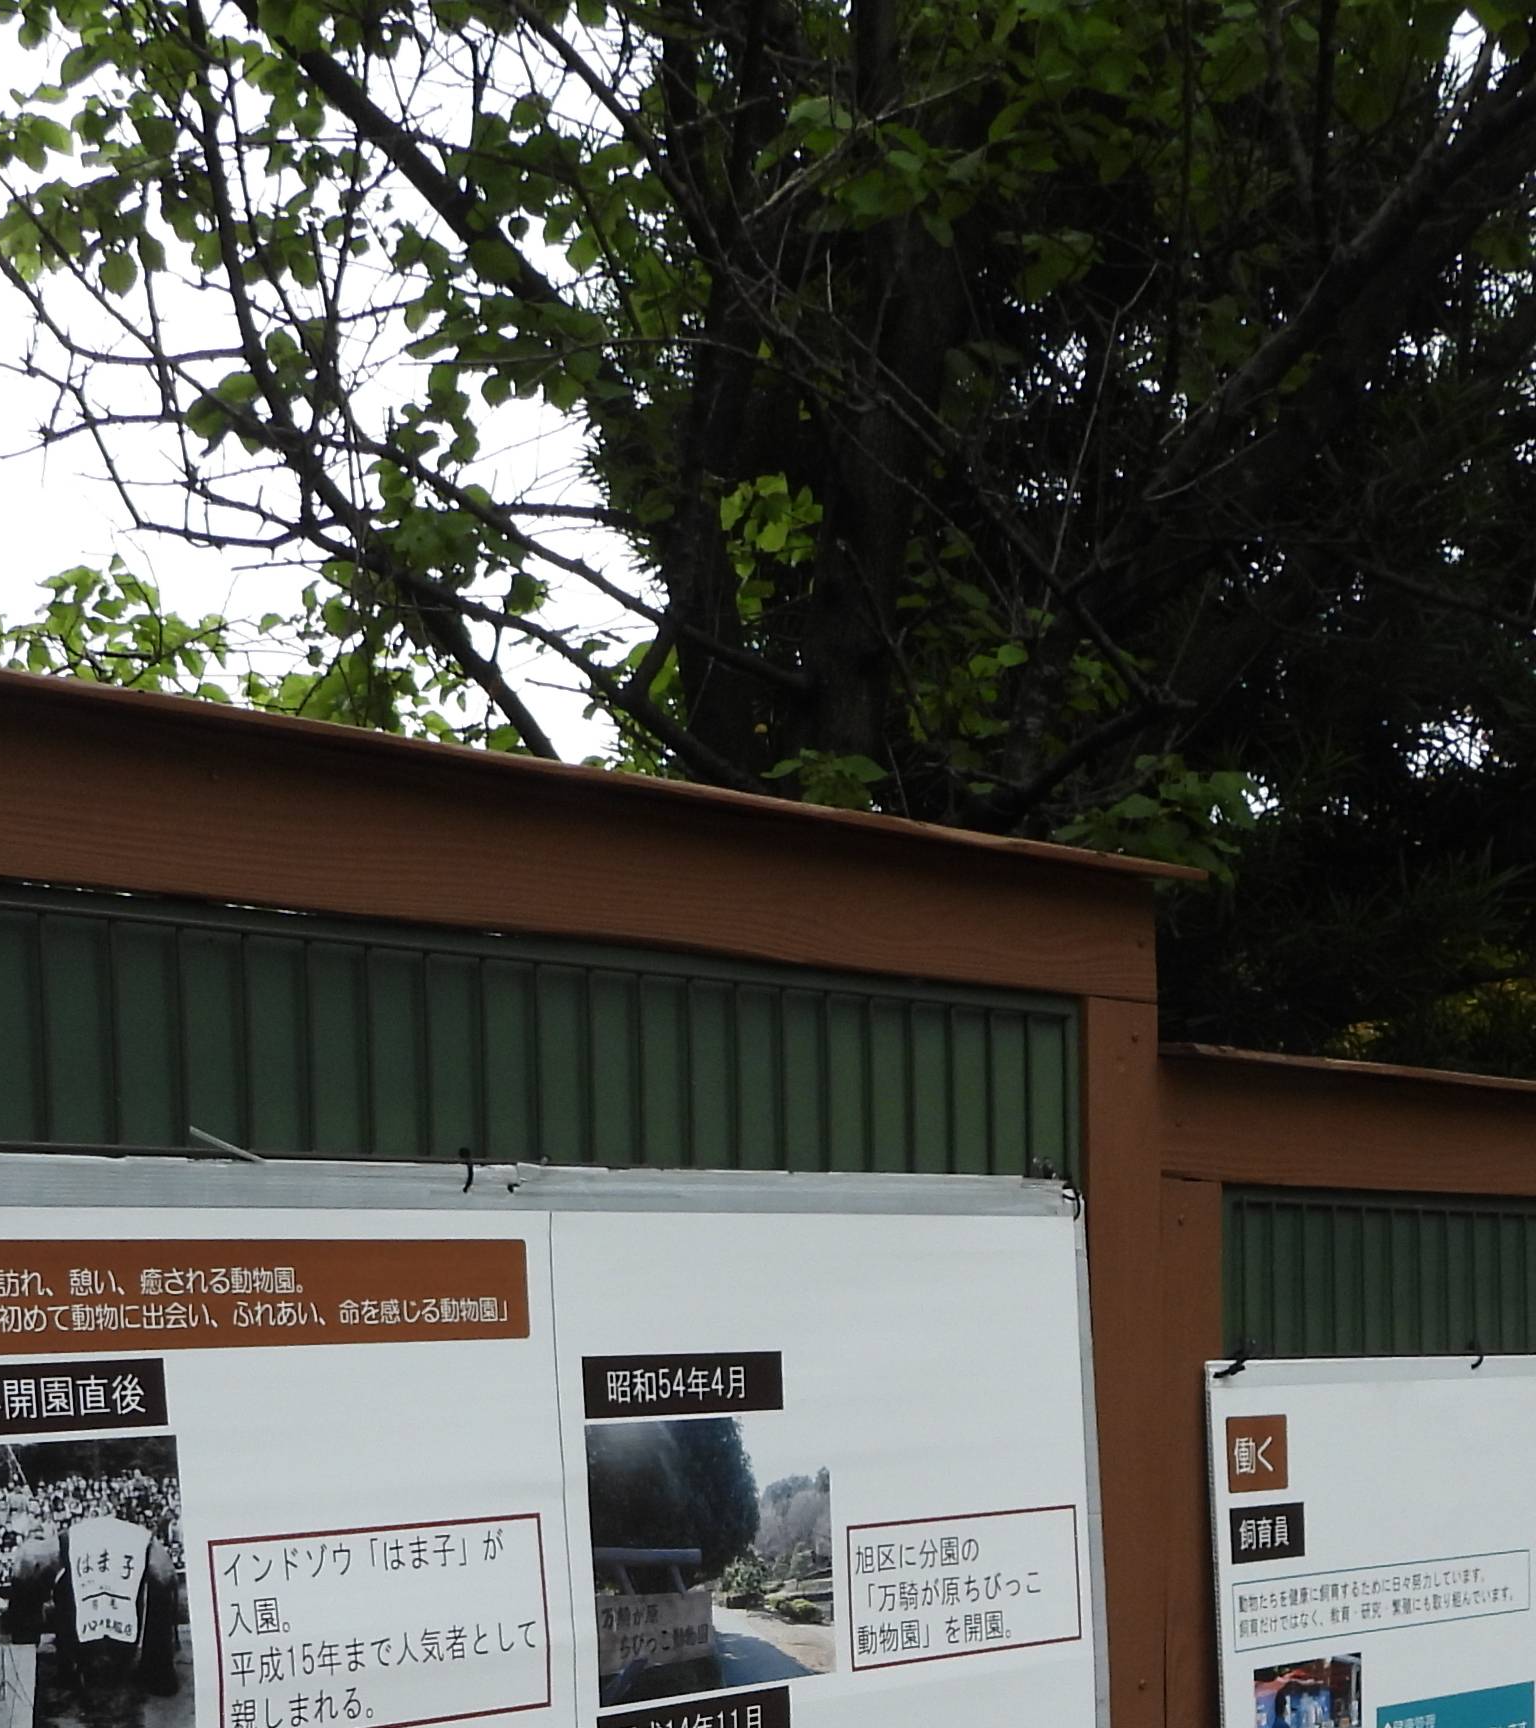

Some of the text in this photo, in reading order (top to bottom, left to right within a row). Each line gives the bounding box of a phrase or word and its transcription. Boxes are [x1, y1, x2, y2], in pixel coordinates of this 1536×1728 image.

[606, 1366, 747, 1403] 昭和54年4月
[1234, 1436, 1274, 1475] 働く
[1239, 1515, 1290, 1550] 飼育員
[222, 1530, 504, 1586] インドゾウ「はま子」が
[855, 1536, 979, 1575] 旭区に分園の
[867, 1571, 1042, 1612] 「万騎が原ちびっこ
[227, 1598, 294, 1638] 入園。
[857, 1610, 1012, 1656] 動物園」を開園。
[229, 1621, 537, 1684] 平成15年まで人気者として
